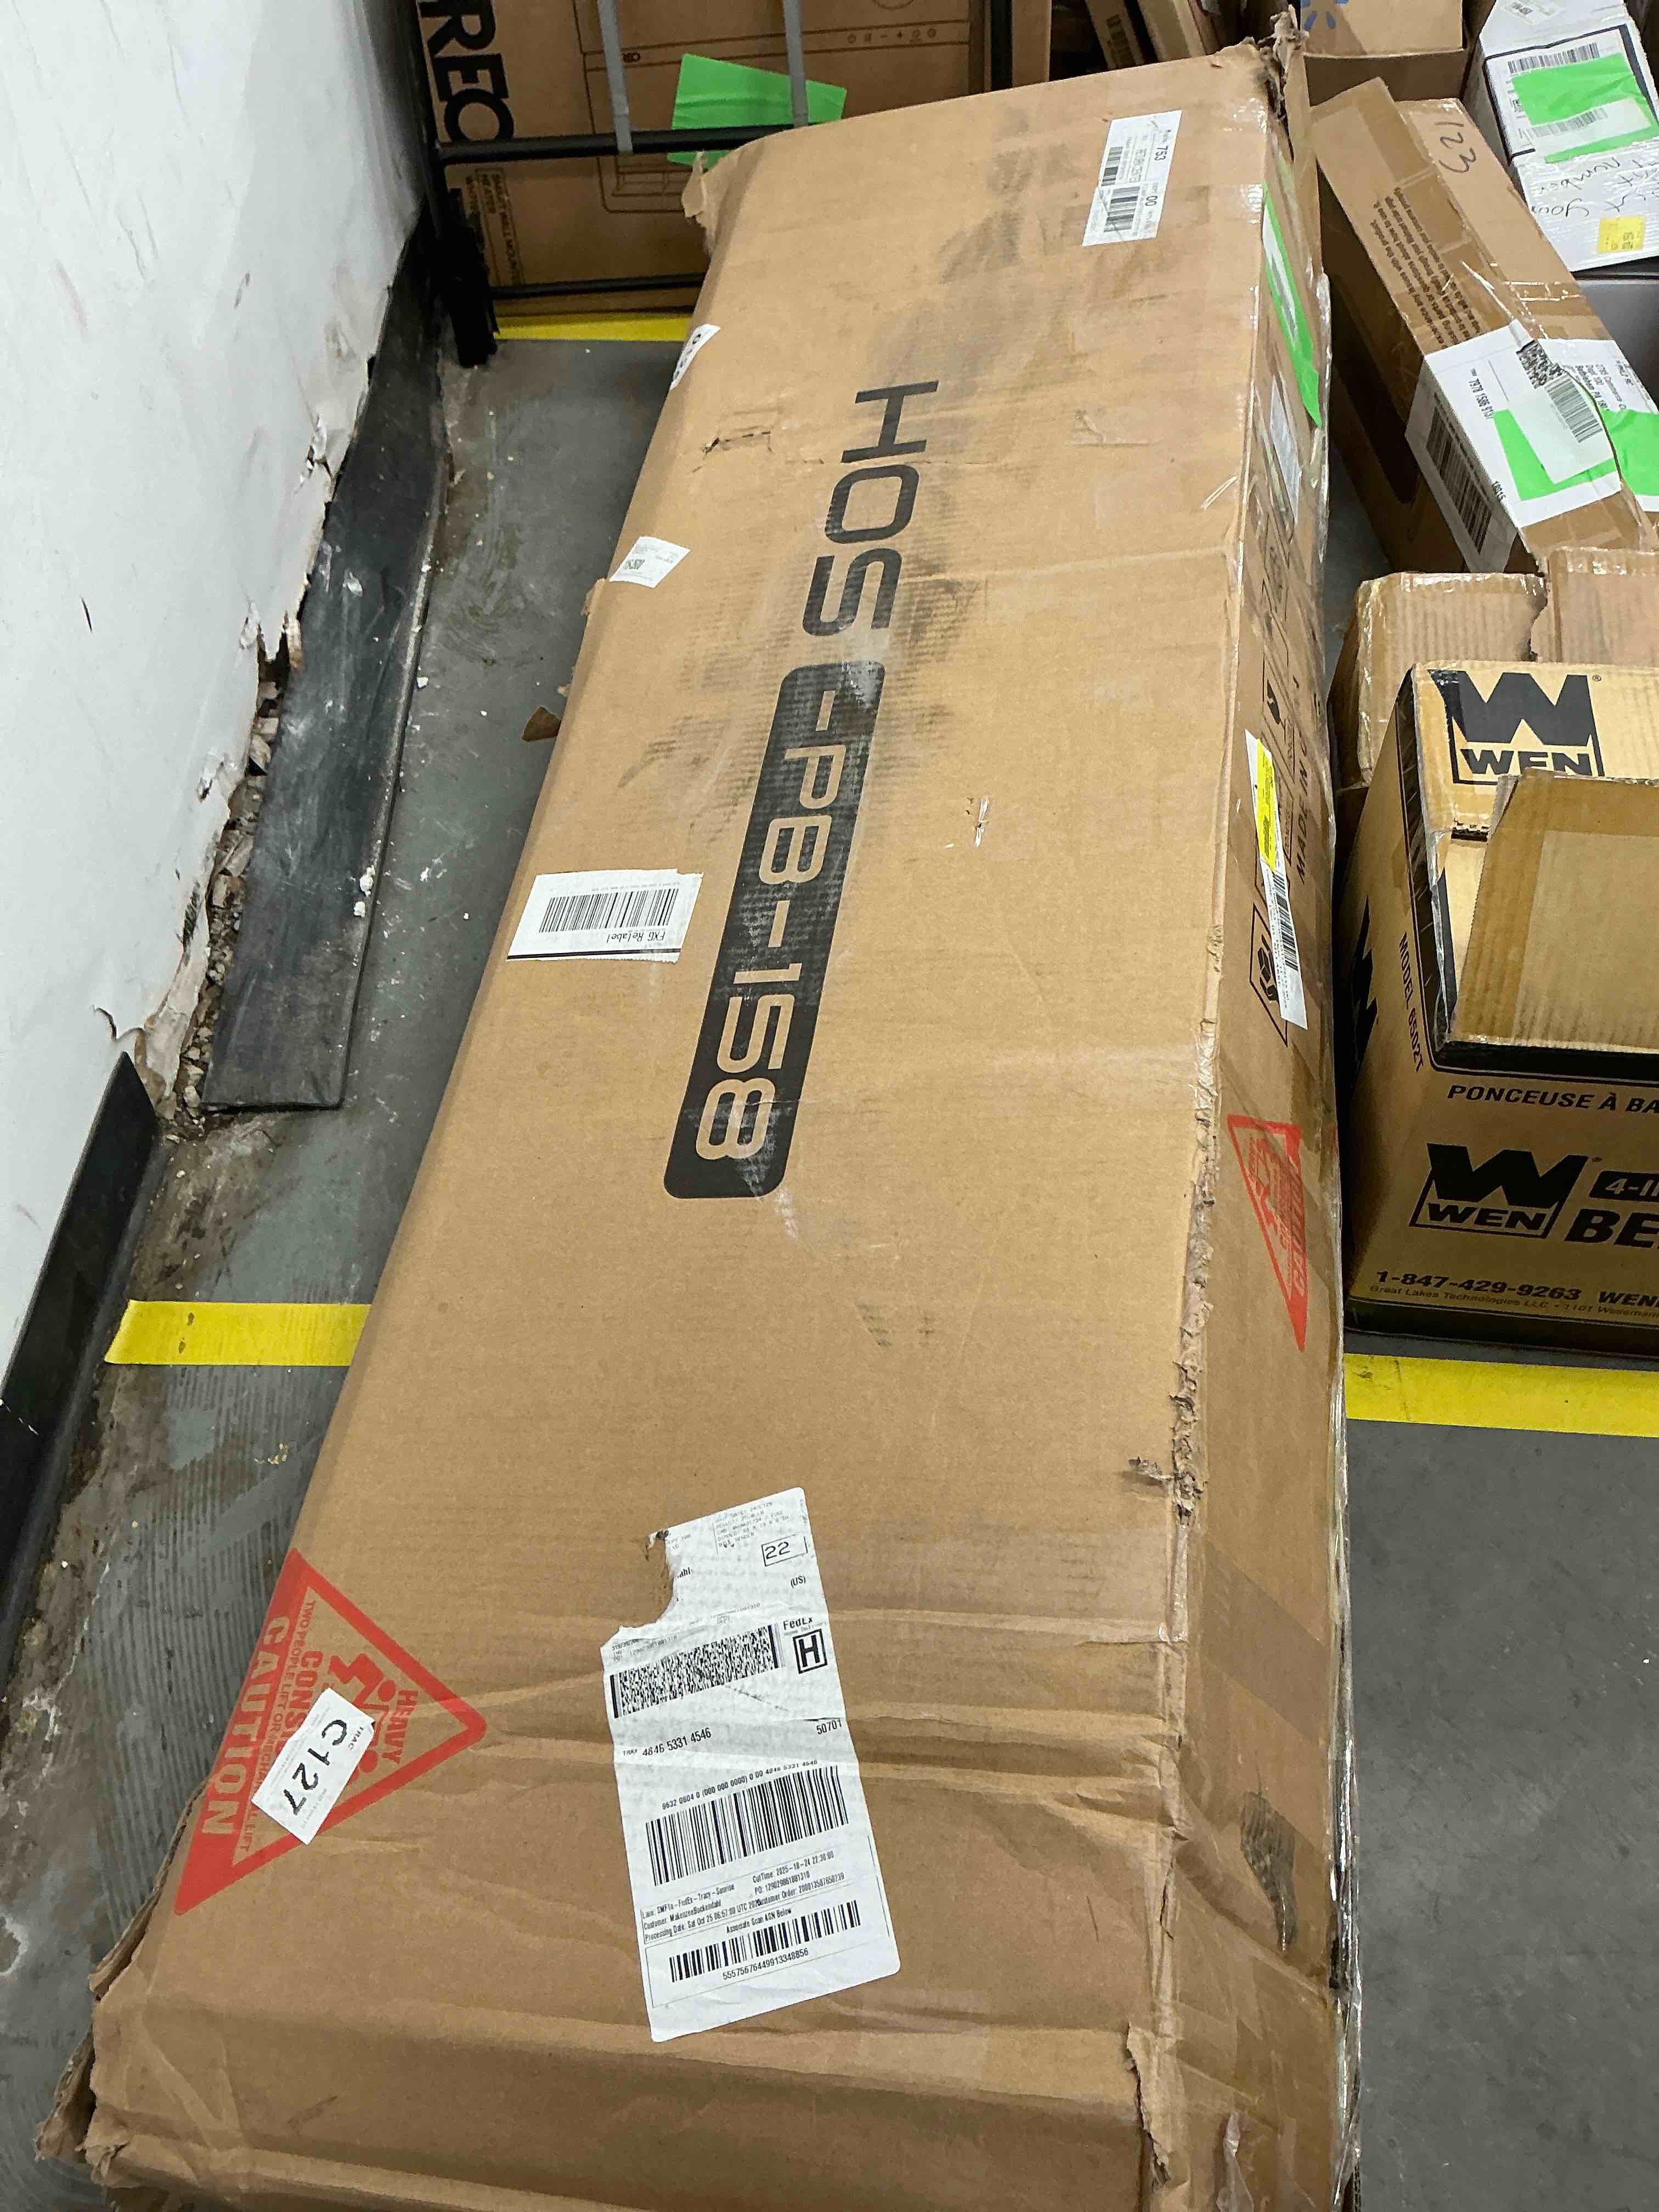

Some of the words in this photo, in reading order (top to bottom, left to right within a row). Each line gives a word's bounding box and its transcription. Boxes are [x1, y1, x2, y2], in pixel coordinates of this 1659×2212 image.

[1154, 145, 1169, 162] 753
[1434, 121, 1476, 173] 123
[803, 380, 940, 637] HOS
[606, 932, 644, 944] Relabel
[647, 931, 665, 941] FXG
[1397, 932, 1410, 1009] MODEL
[1447, 1085, 1595, 1109] PONCEUSE
[1428, 1203, 1547, 1230] WEN
[1370, 1285, 1401, 1295] Great
[1406, 1288, 1438, 1299] Lakes
[1443, 1292, 1520, 1306] Technologies
[1524, 1300, 1546, 1309] LLC
[1376, 1270, 1582, 1301] 1-847-429-9263
[764, 1541, 791, 1559] 22
[789, 1574, 807, 1589] (US)
[782, 1614, 814, 1630] FedEx
[798, 1634, 821, 1668] H
[202, 1616, 291, 1835] CAUTION
[382, 1689, 419, 1765] HEAVY
[816, 1719, 842, 1735] 50701
[641, 1742, 665, 1757] 4846
[665, 1735, 688, 1751] 5331
[689, 1726, 712, 1743] 4546
[283, 1719, 347, 1816] C127
[705, 1913, 714, 1922] 25
[736, 1903, 748, 1913] UTC
[775, 1906, 792, 1917] Below
